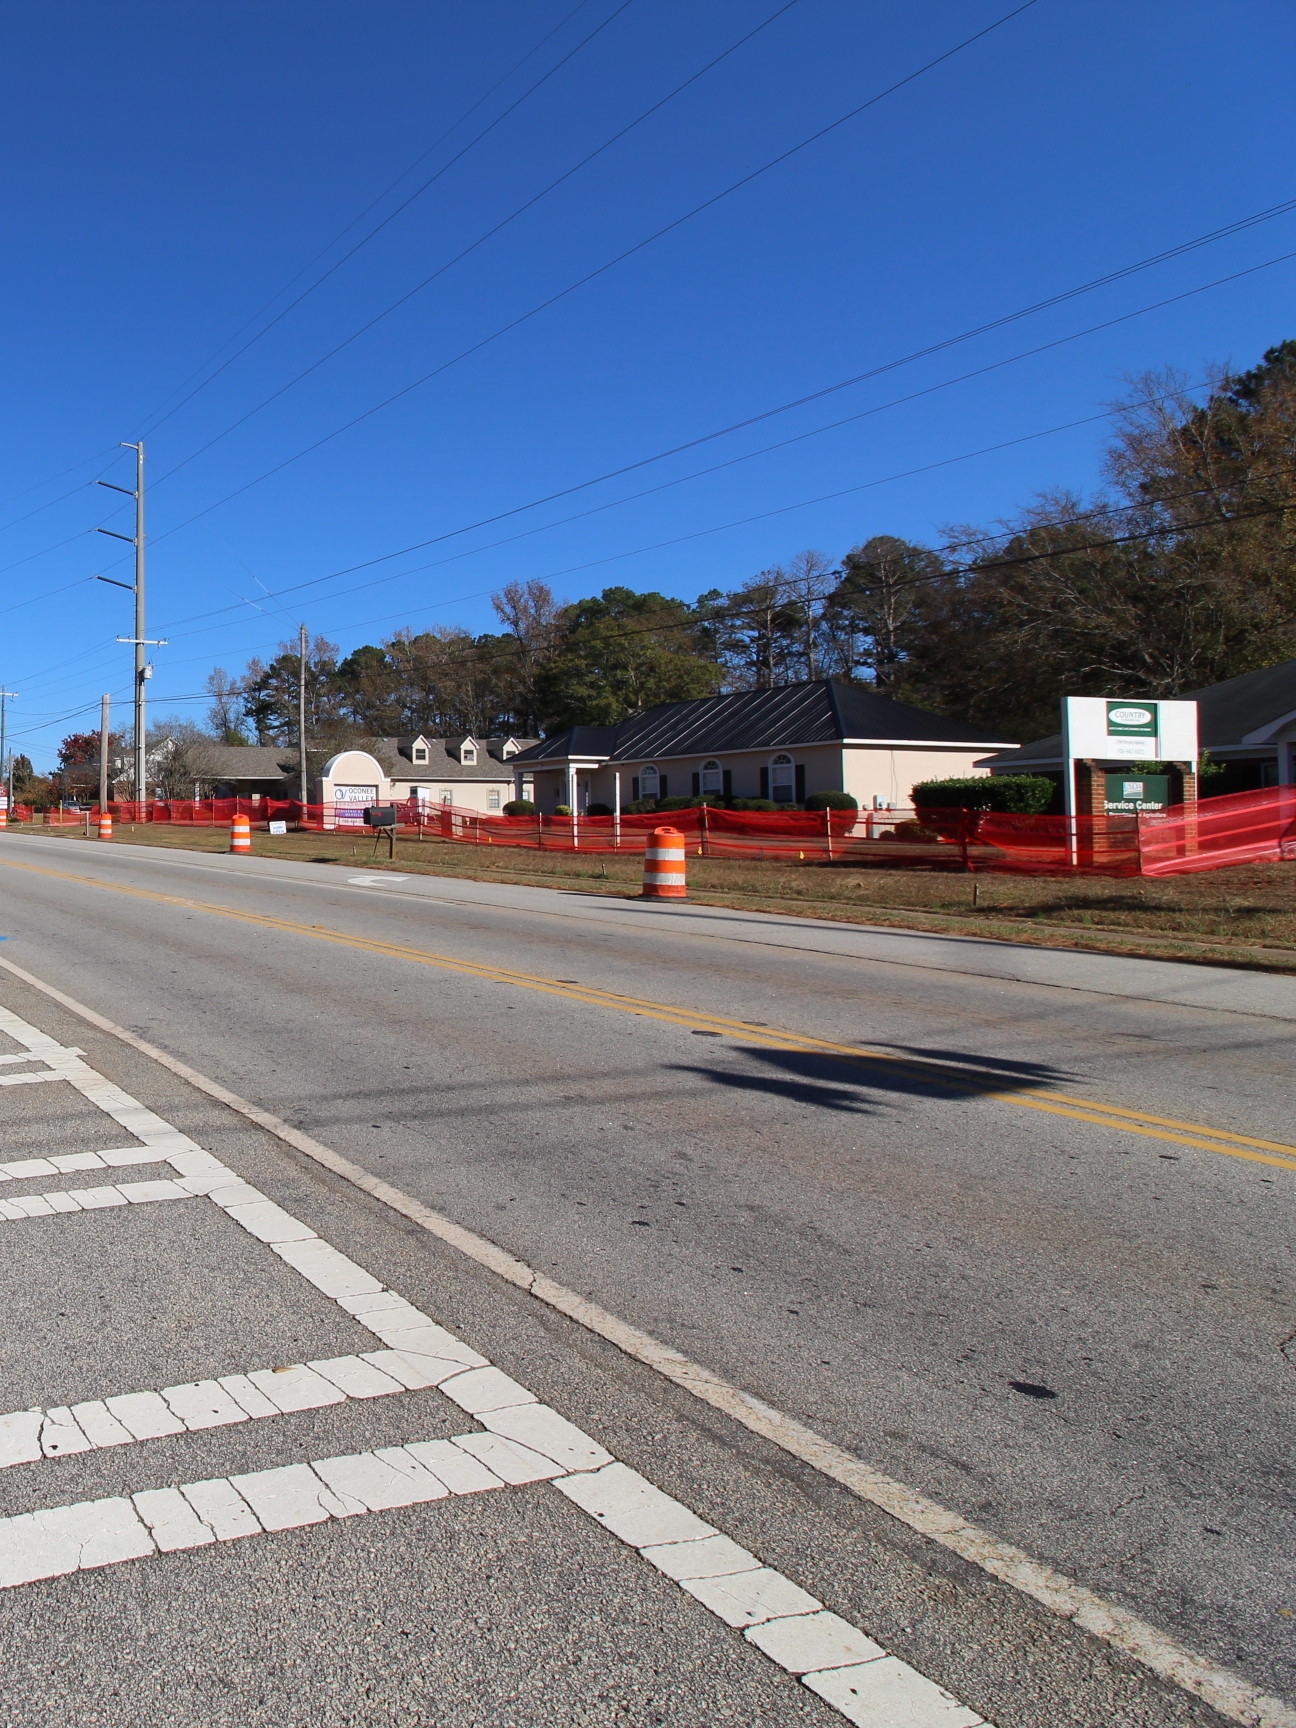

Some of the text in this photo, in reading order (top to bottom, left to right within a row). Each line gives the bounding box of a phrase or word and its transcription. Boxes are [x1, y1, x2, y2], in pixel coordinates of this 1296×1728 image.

[348, 787, 375, 795] OCONEE
[1103, 800, 1163, 810] Service Center
